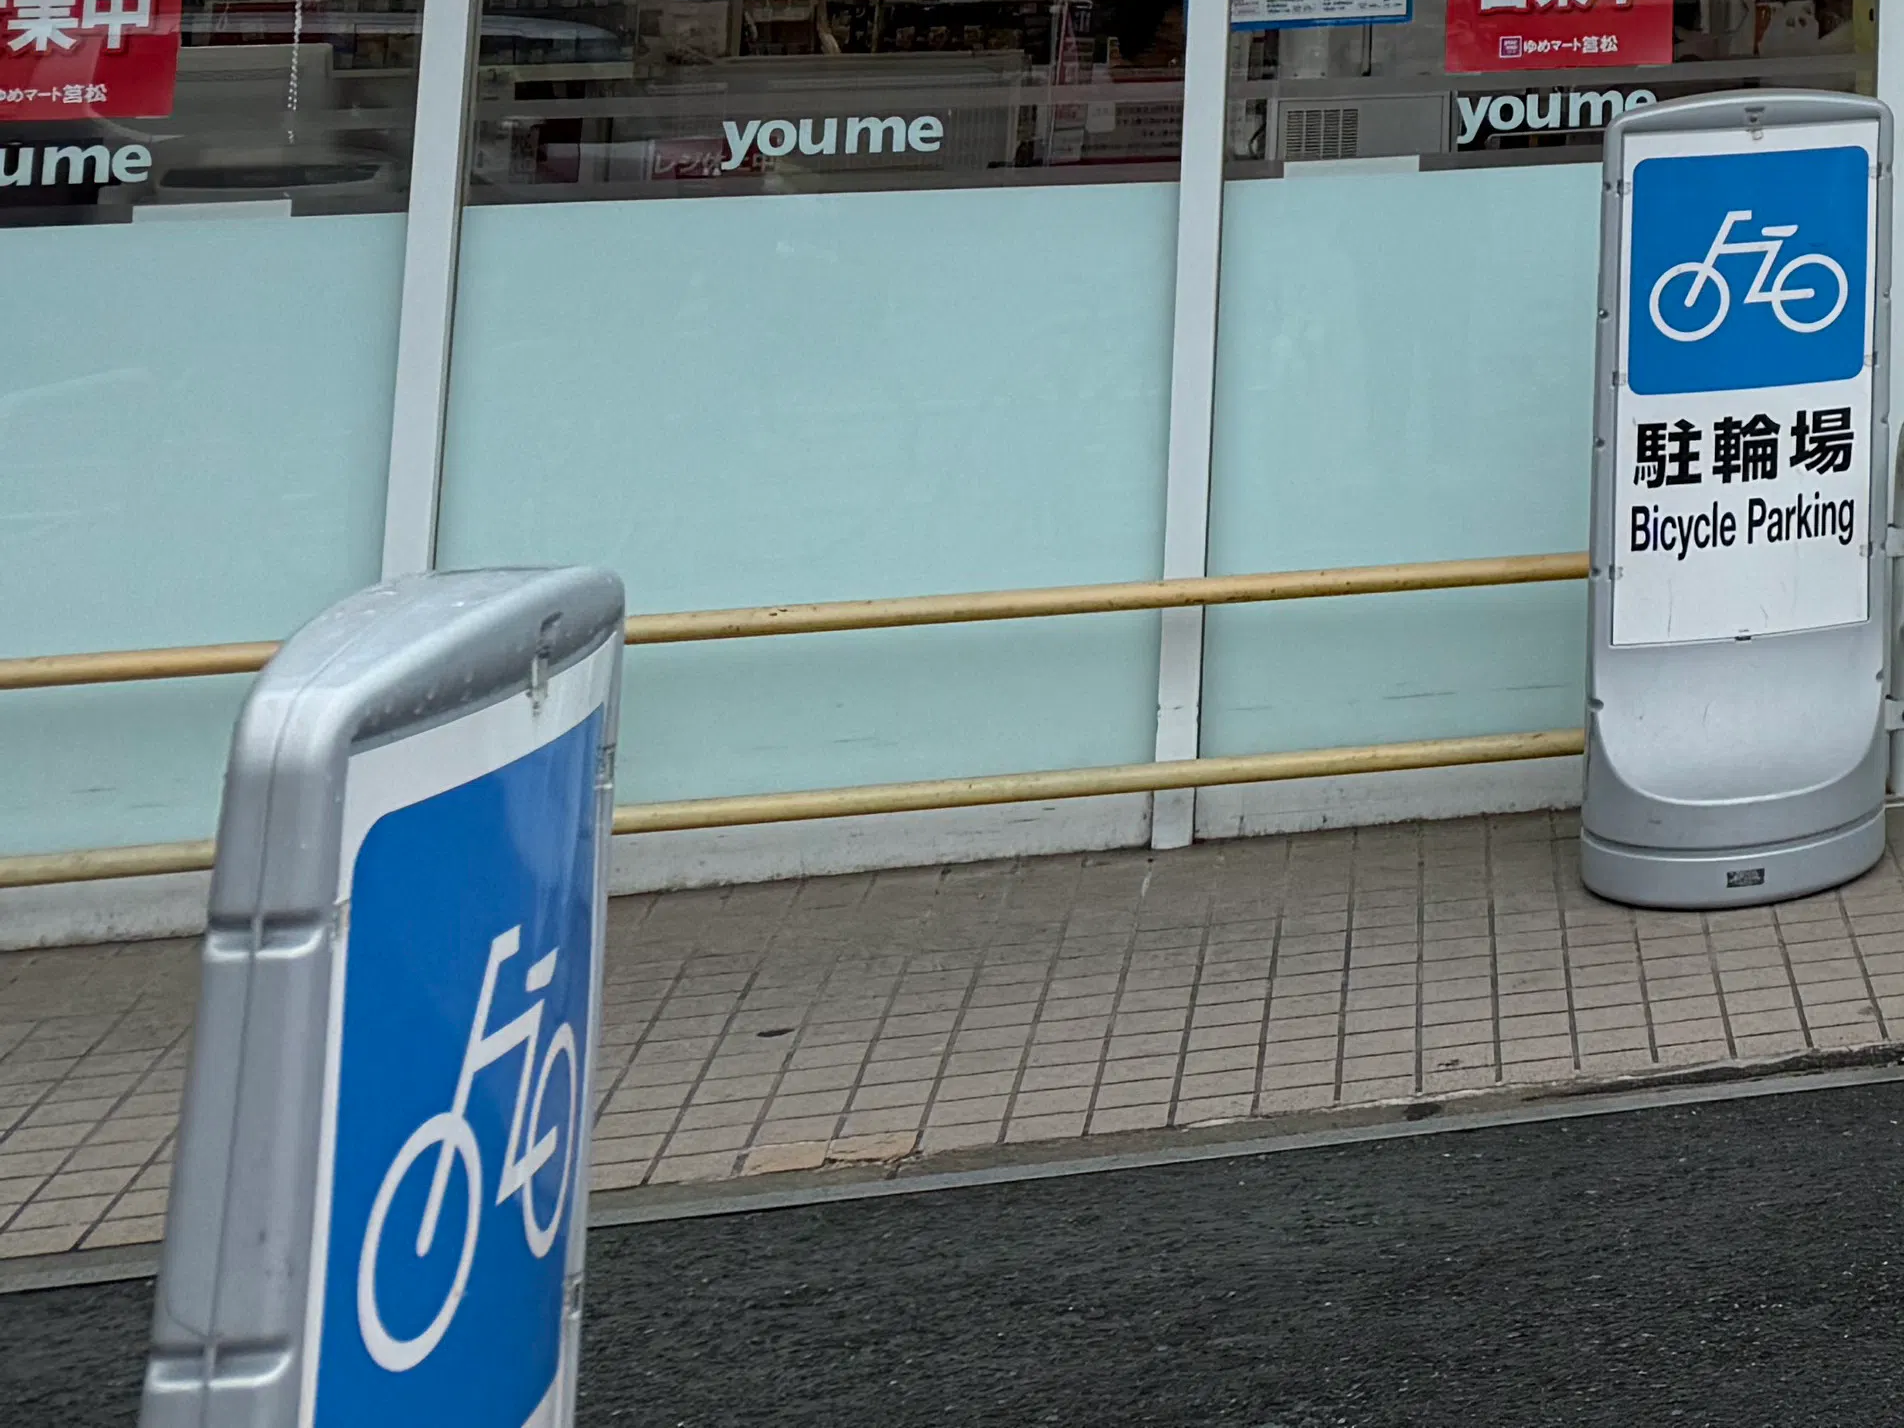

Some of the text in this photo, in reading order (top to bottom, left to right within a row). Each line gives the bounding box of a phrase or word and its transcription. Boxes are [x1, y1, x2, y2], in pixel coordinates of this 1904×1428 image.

[721, 112, 944, 171] youme
[1632, 405, 1855, 489] 駐輪場
[1630, 490, 1856, 560] Bicycle Parking
